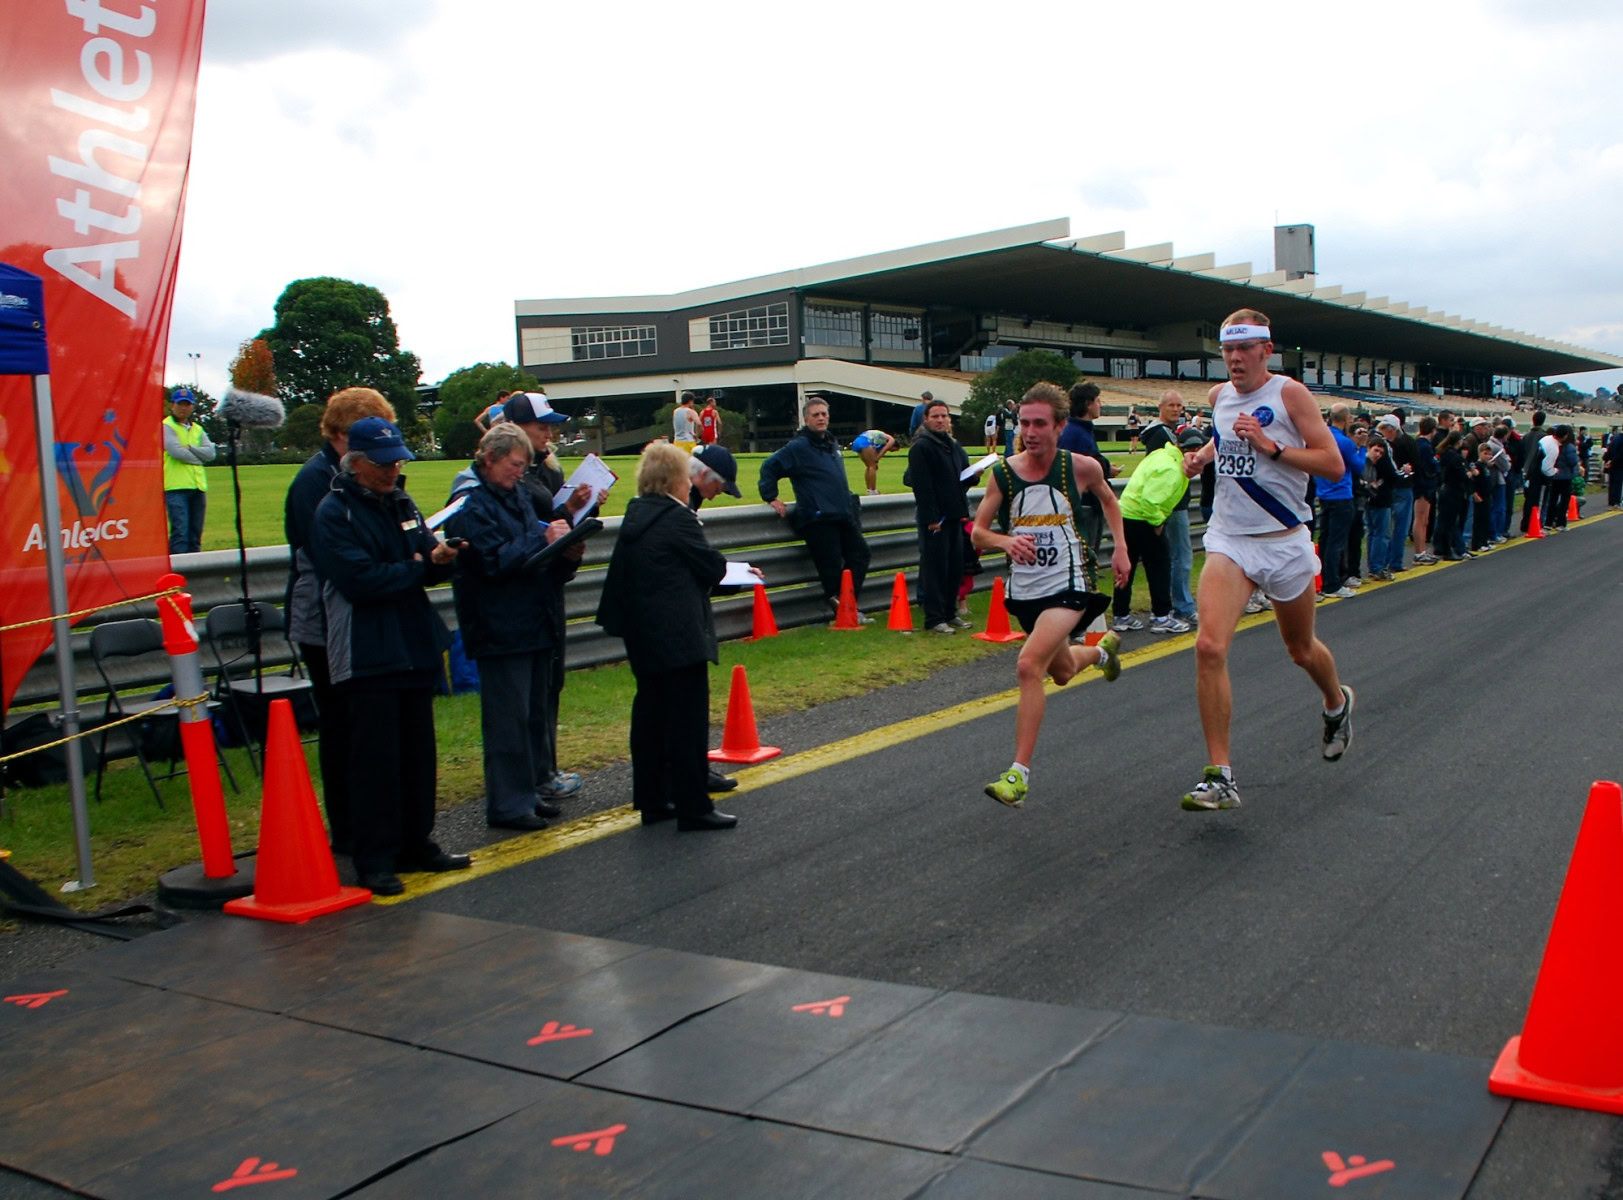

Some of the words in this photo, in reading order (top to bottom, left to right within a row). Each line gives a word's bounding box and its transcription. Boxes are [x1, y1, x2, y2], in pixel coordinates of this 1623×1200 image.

[43, 0, 157, 320] Athlet
[1218, 454, 1256, 476] 2393
[1026, 547, 1058, 567] 92
